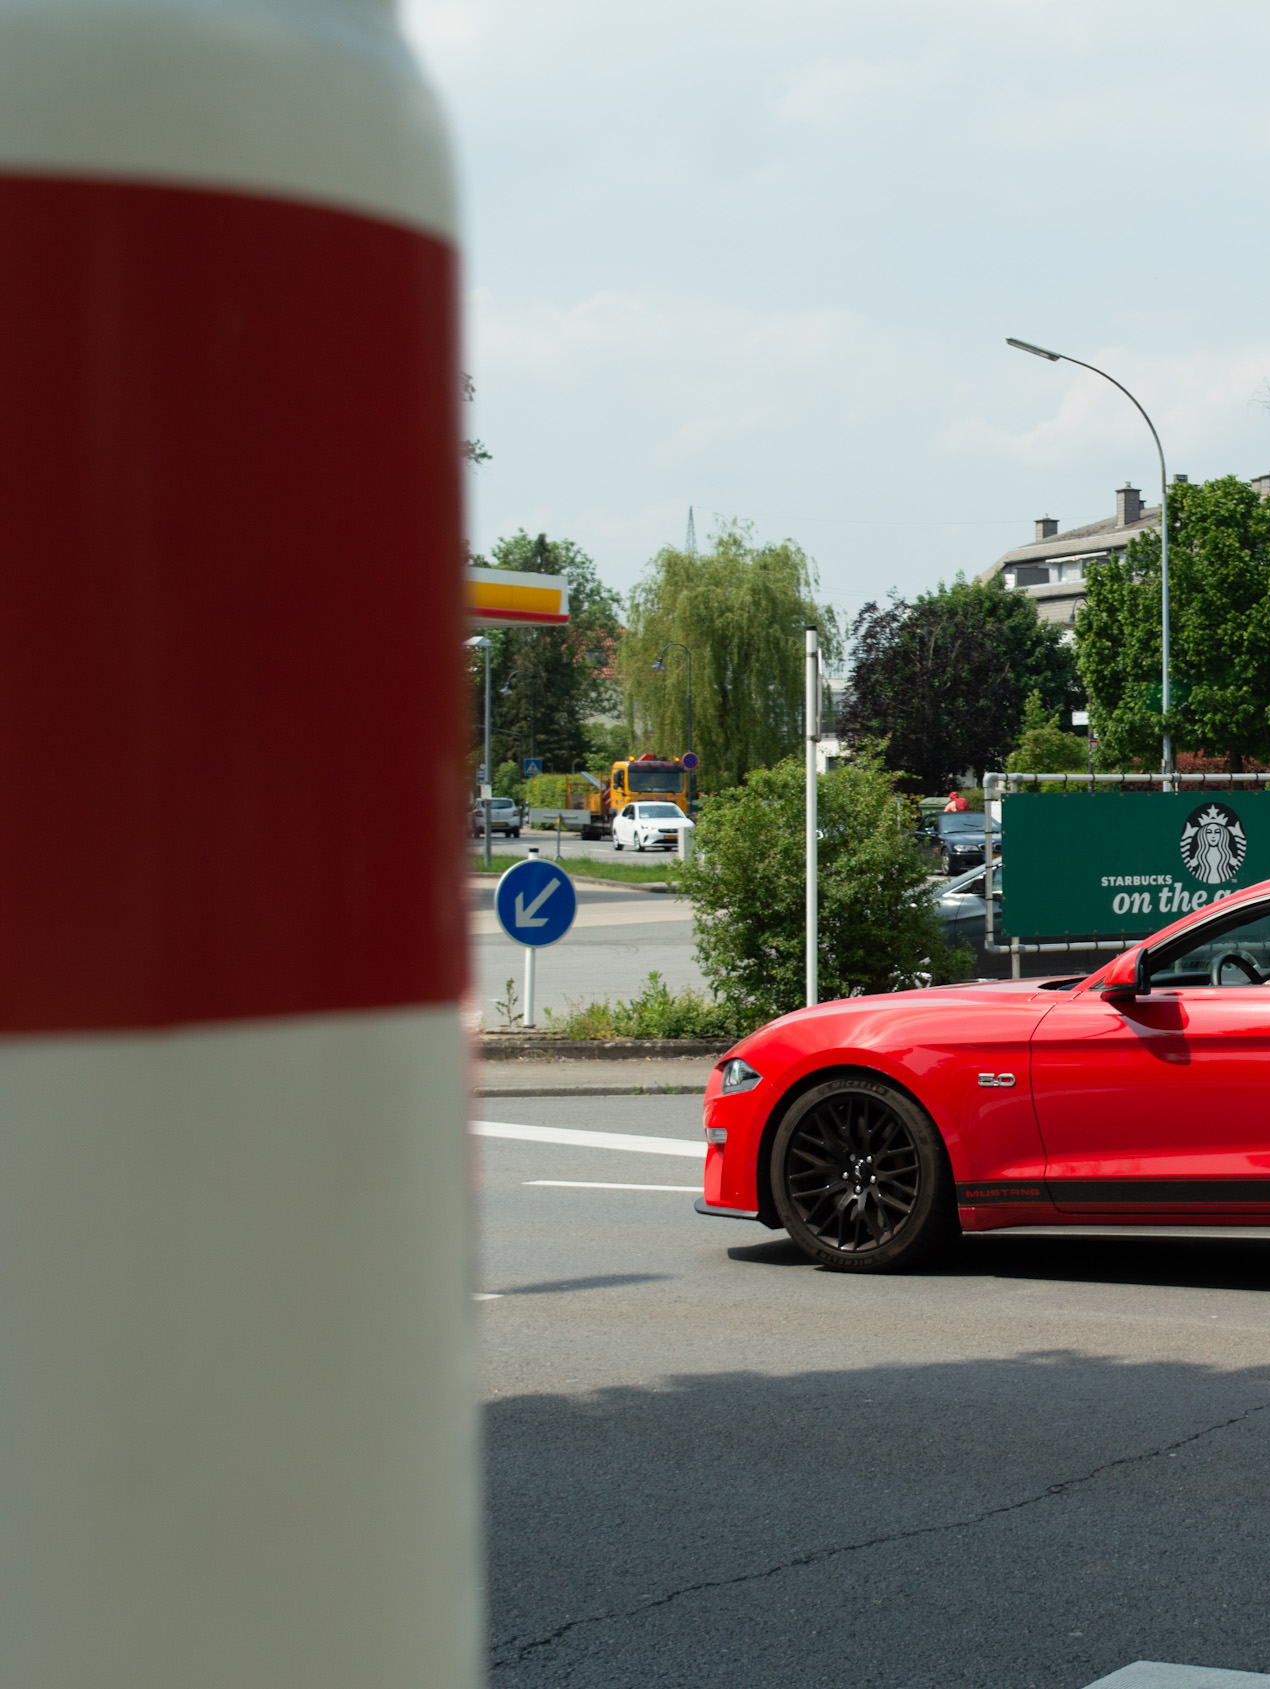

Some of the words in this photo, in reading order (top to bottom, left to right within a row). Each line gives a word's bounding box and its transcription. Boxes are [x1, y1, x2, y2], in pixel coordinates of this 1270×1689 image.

[1101, 875, 1173, 887] STARBUCKS
[1112, 892, 1153, 915] on
[1158, 882, 1208, 913] the
[978, 1073, 1016, 1087] 5.0
[965, 1188, 1041, 1198] MUSTANG
